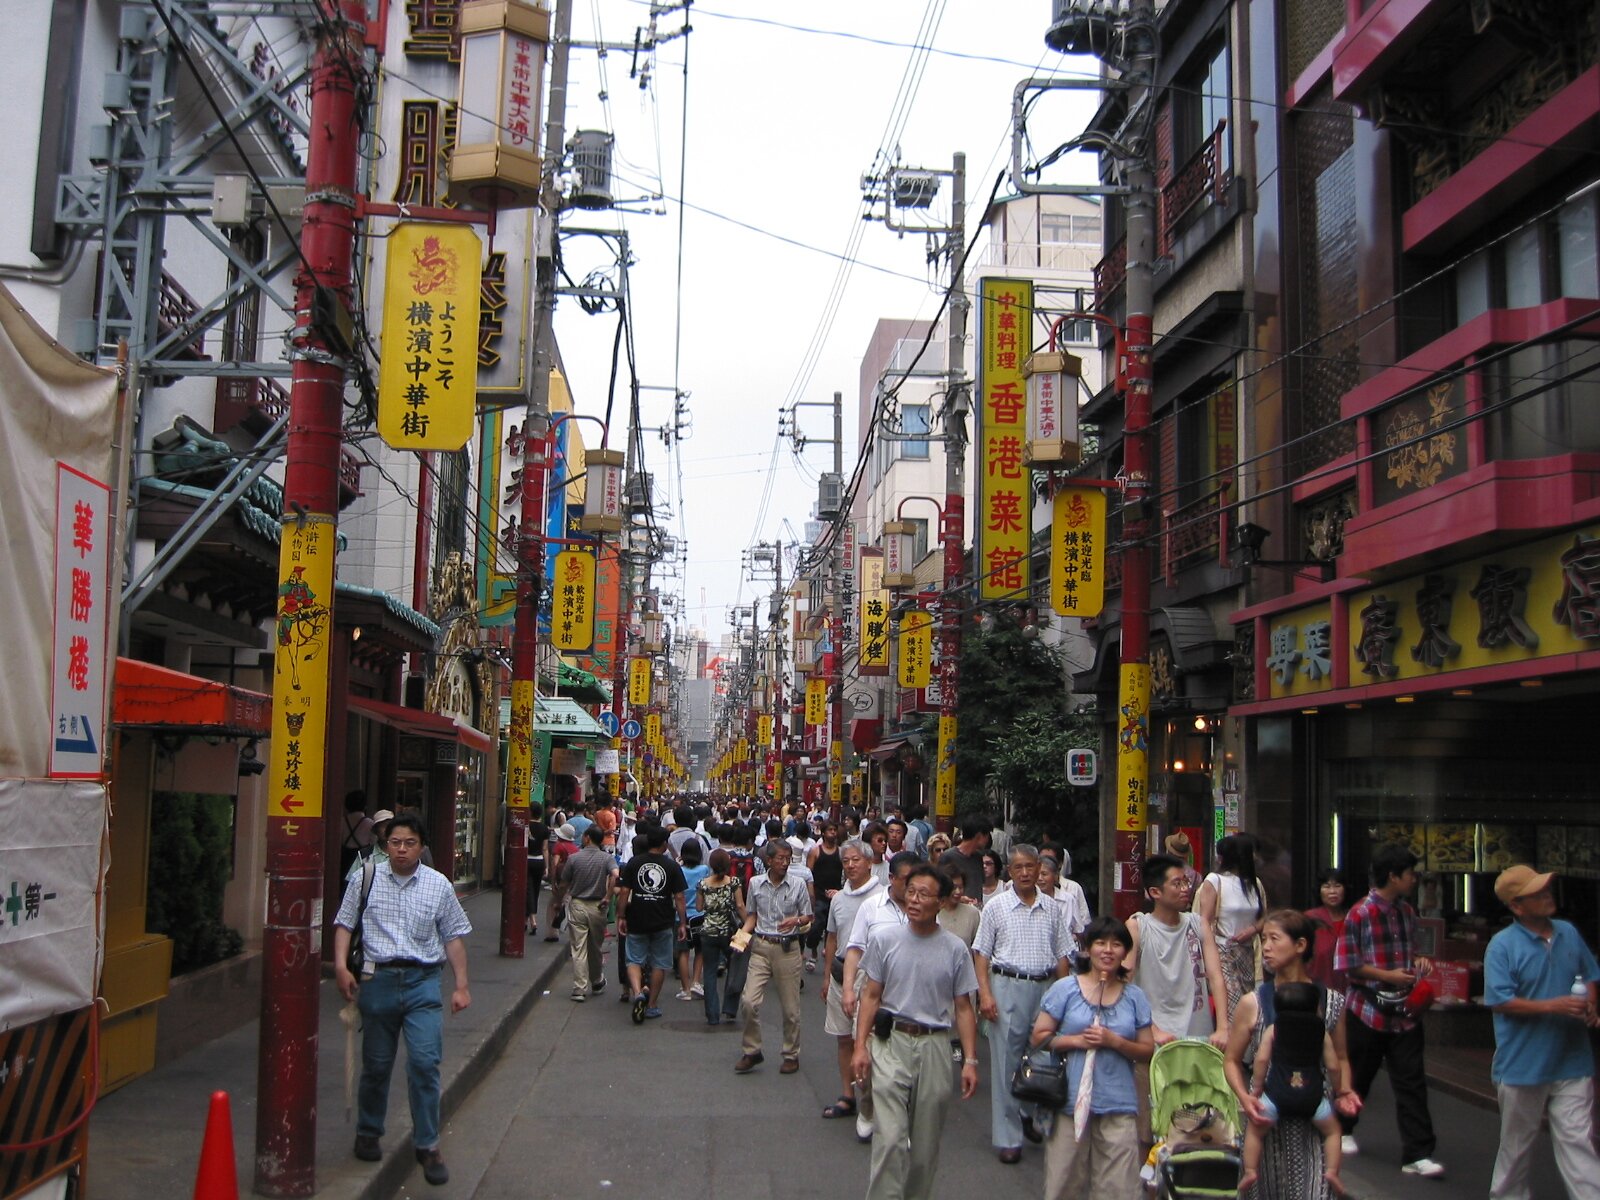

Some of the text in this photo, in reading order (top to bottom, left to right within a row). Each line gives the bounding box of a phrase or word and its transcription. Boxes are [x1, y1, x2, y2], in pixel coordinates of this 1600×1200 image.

[435, 301, 456, 390] ようこそ
[997, 292, 1017, 369] 中華料理
[987, 383, 1025, 589] 香港菜館
[26, 882, 57, 920] 第一
